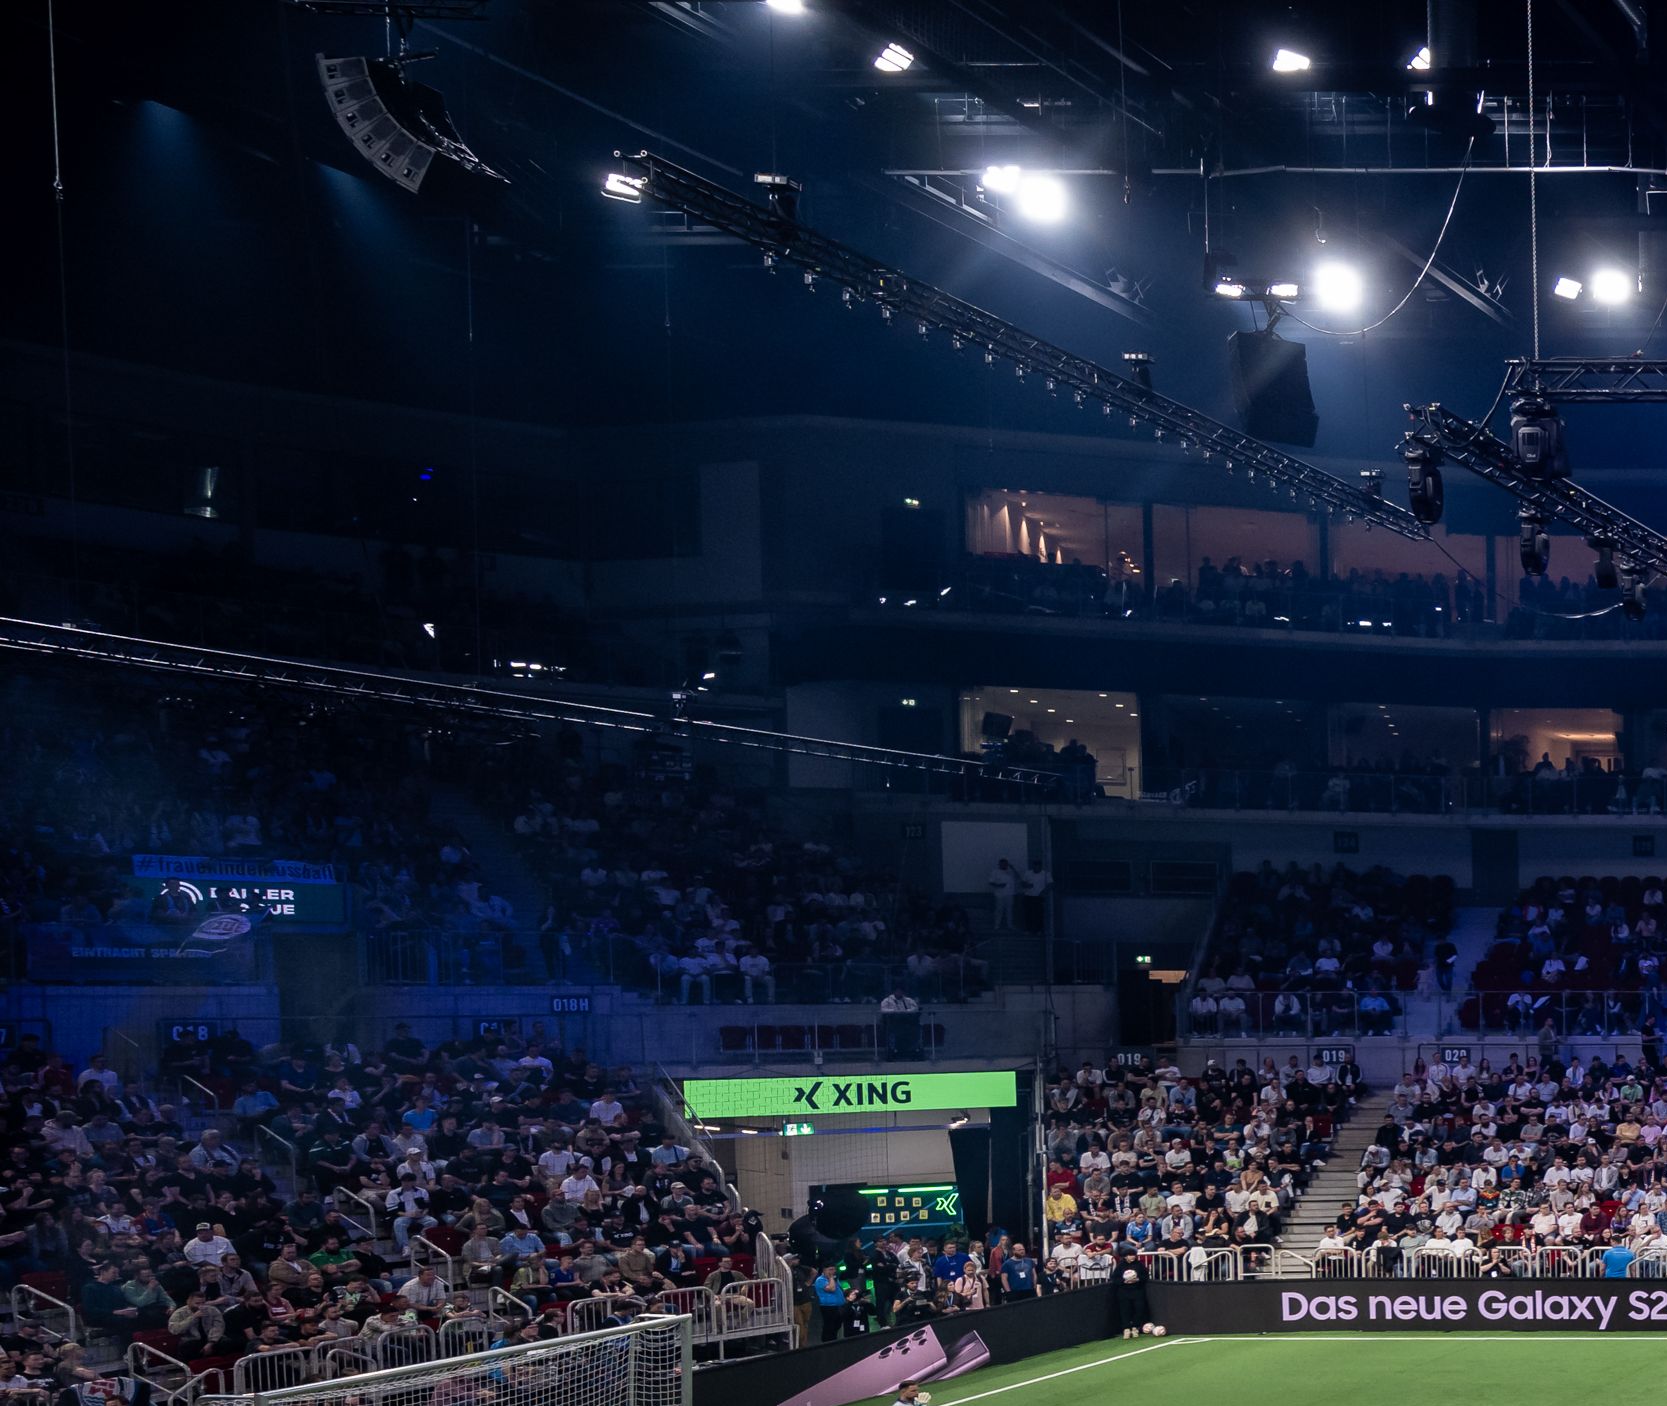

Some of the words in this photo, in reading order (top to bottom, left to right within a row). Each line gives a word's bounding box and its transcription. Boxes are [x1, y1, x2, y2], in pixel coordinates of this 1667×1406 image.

[1322, 1050, 1346, 1062] 019
[831, 1080, 912, 1106] XING
[1281, 1292, 1358, 1321] Das
[1369, 1297, 1467, 1321] neue
[1478, 1290, 1617, 1330] Galaxy
